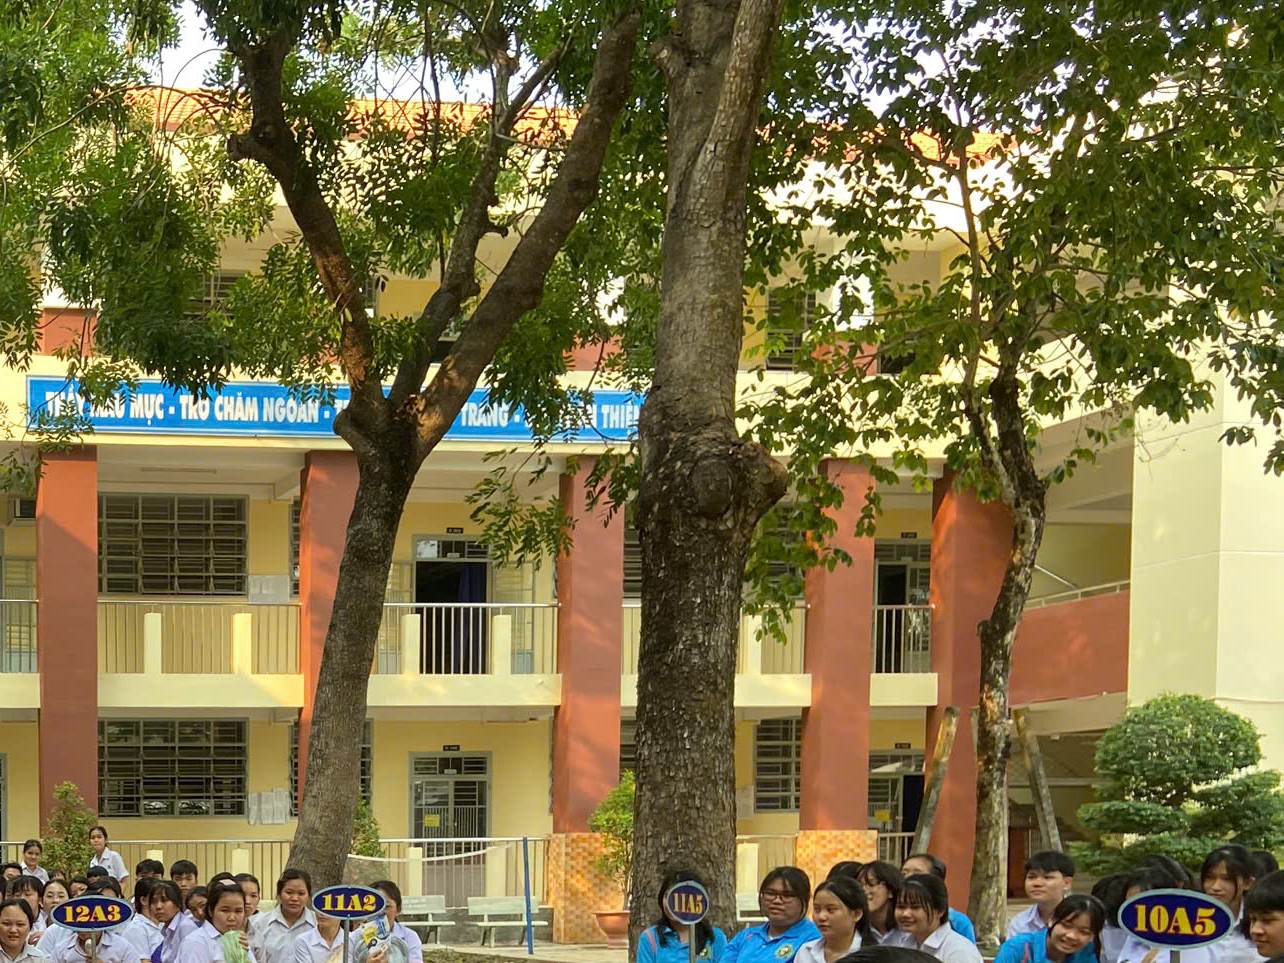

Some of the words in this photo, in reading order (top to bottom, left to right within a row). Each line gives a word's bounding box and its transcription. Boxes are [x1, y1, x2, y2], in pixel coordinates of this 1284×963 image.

[215, 392, 258, 421] CHĂM
[263, 397, 319, 423] NGOAN
[460, 401, 509, 427] TRANG
[63, 904, 121, 923] 12A3
[321, 893, 376, 912] 11A2
[1134, 903, 1216, 936] 10A5
